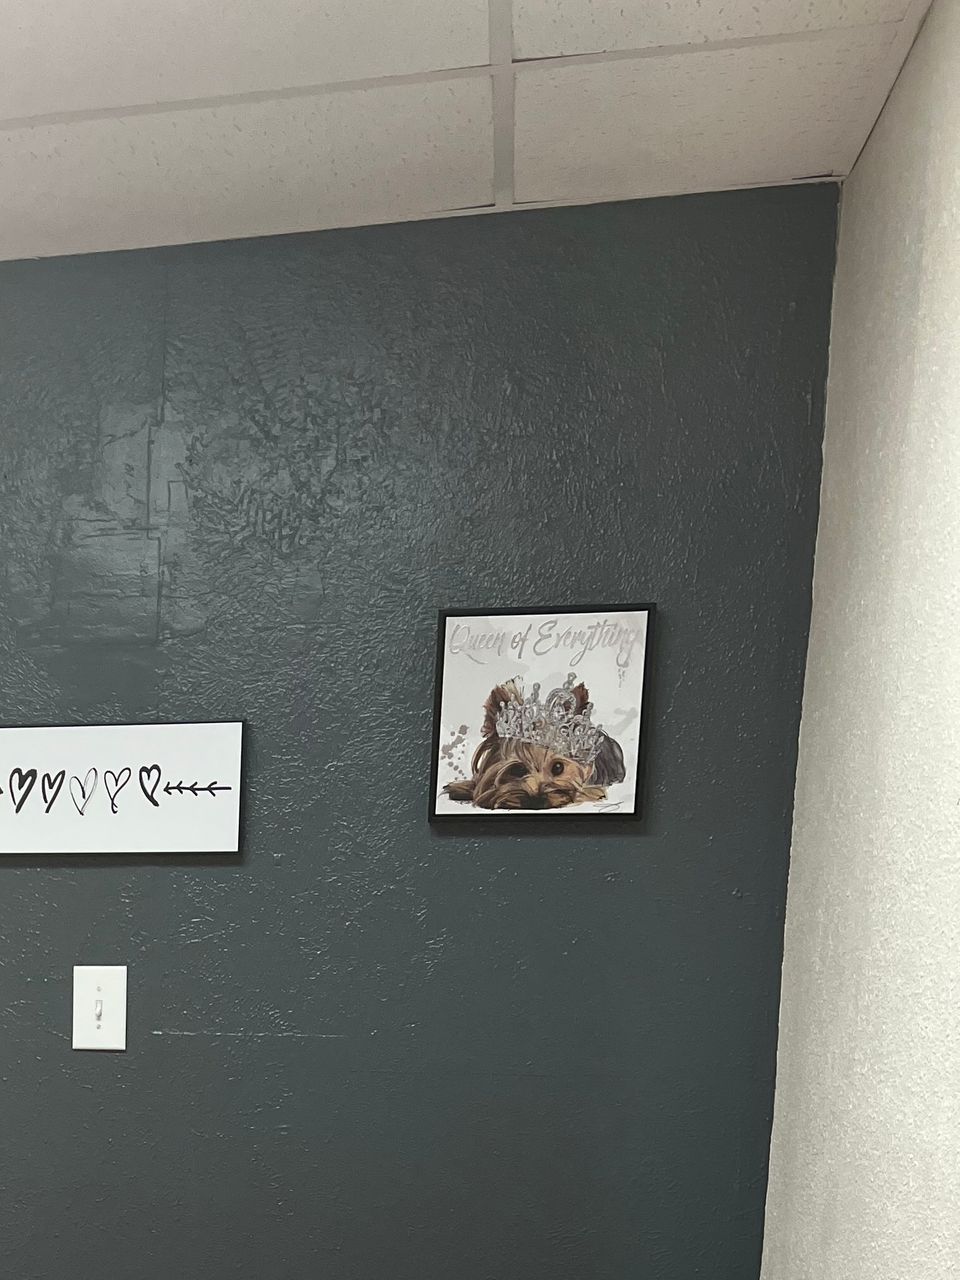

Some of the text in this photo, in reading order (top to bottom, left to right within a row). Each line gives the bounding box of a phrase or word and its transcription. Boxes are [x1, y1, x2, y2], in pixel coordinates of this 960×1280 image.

[449, 619, 639, 668] Queen of Everything
